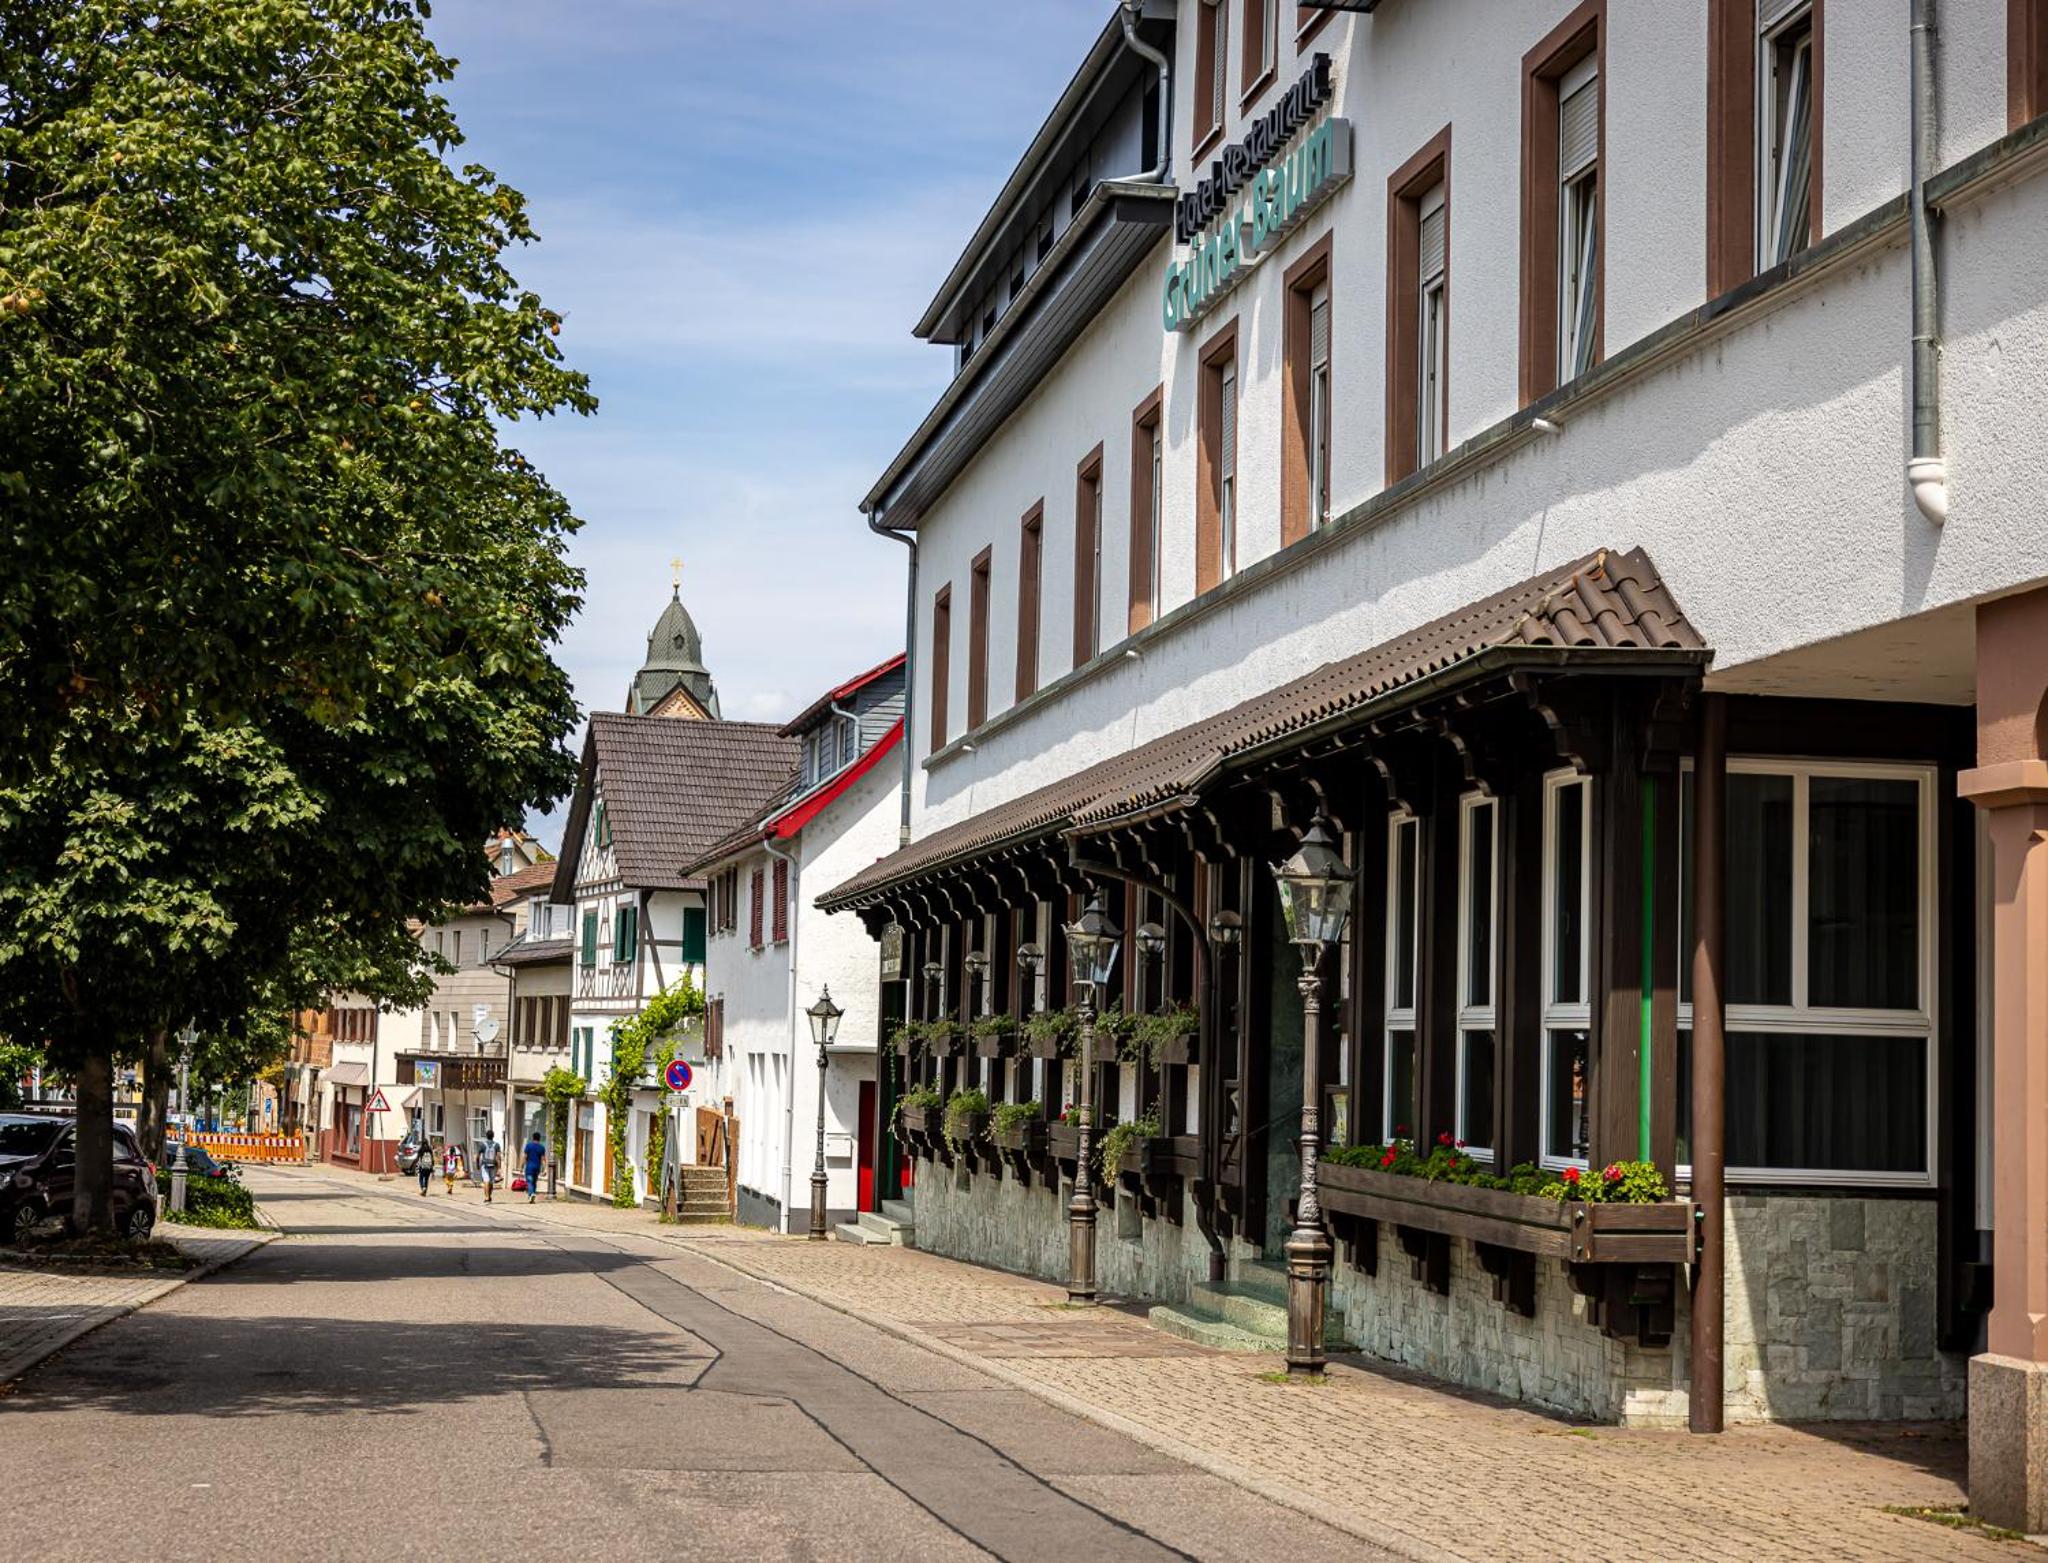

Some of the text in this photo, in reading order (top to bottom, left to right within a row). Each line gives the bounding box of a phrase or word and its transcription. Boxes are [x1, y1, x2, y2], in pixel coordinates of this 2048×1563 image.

[1163, 117, 1338, 332] Grüner Baum
[1176, 52, 1331, 245] Hotel-Restaurant
